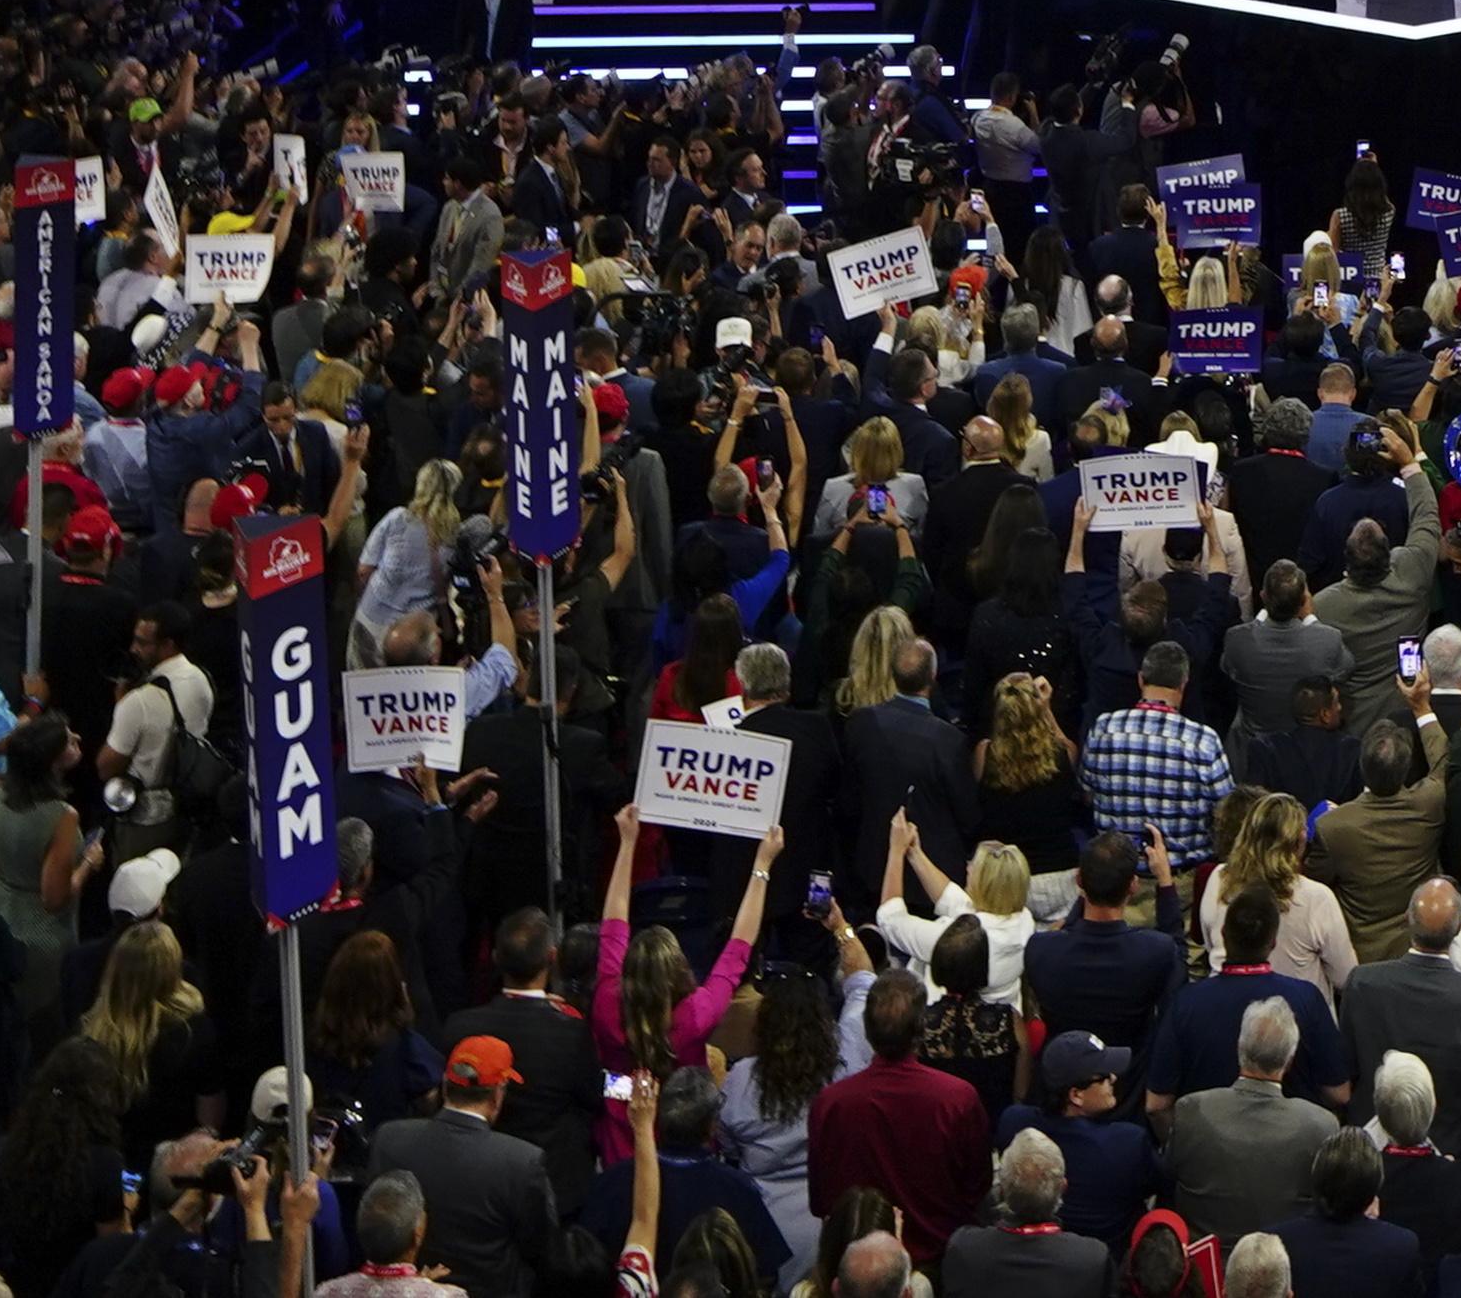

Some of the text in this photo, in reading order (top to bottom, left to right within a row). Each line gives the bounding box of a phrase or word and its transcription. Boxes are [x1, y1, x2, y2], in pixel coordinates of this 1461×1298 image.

[351, 166, 401, 181] TRUMP
[358, 180, 397, 193] VANCE
[1183, 197, 1256, 216] TRUMP
[195, 251, 267, 267] TRUMP
[840, 245, 920, 281] TRUMP
[204, 266, 259, 281] VANCE
[853, 263, 916, 291] VANCE
[37, 210, 54, 423] AMERICAN SAMOA
[1178, 320, 1256, 340] TRUMP
[510, 333, 533, 520] MAINE
[543, 331, 570, 517] MAINE
[1091, 470, 1189, 492] TRUMP
[1103, 487, 1180, 504] VANCE
[356, 692, 457, 718] TRUMP
[372, 713, 449, 736] VANCE
[271, 625, 324, 860] GUAM
[657, 745, 776, 780] TRUMP
[666, 771, 760, 801] VANCE
